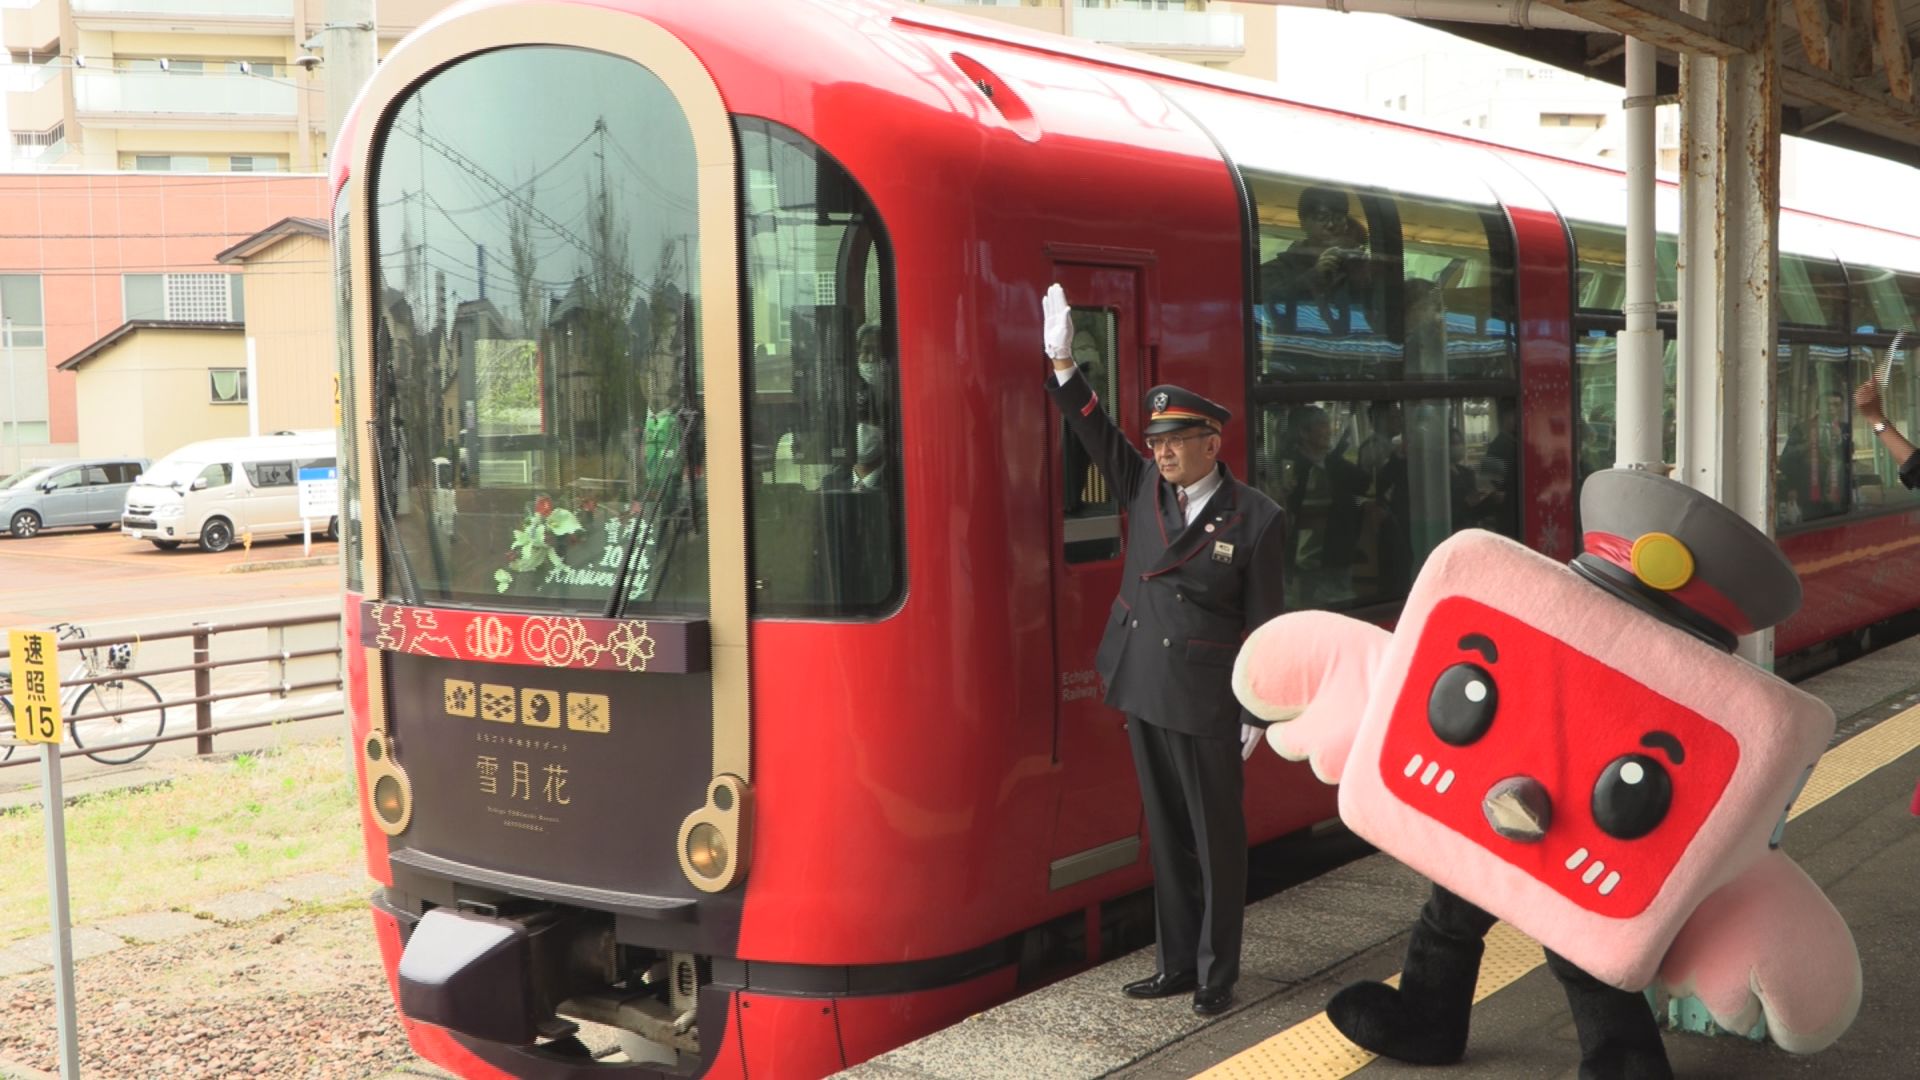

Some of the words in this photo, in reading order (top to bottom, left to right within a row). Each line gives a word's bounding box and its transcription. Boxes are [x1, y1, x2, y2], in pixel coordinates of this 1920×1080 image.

[23, 634, 47, 702] 速照
[25, 704, 54, 738] 15
[476, 755, 571, 805] 雪月花
